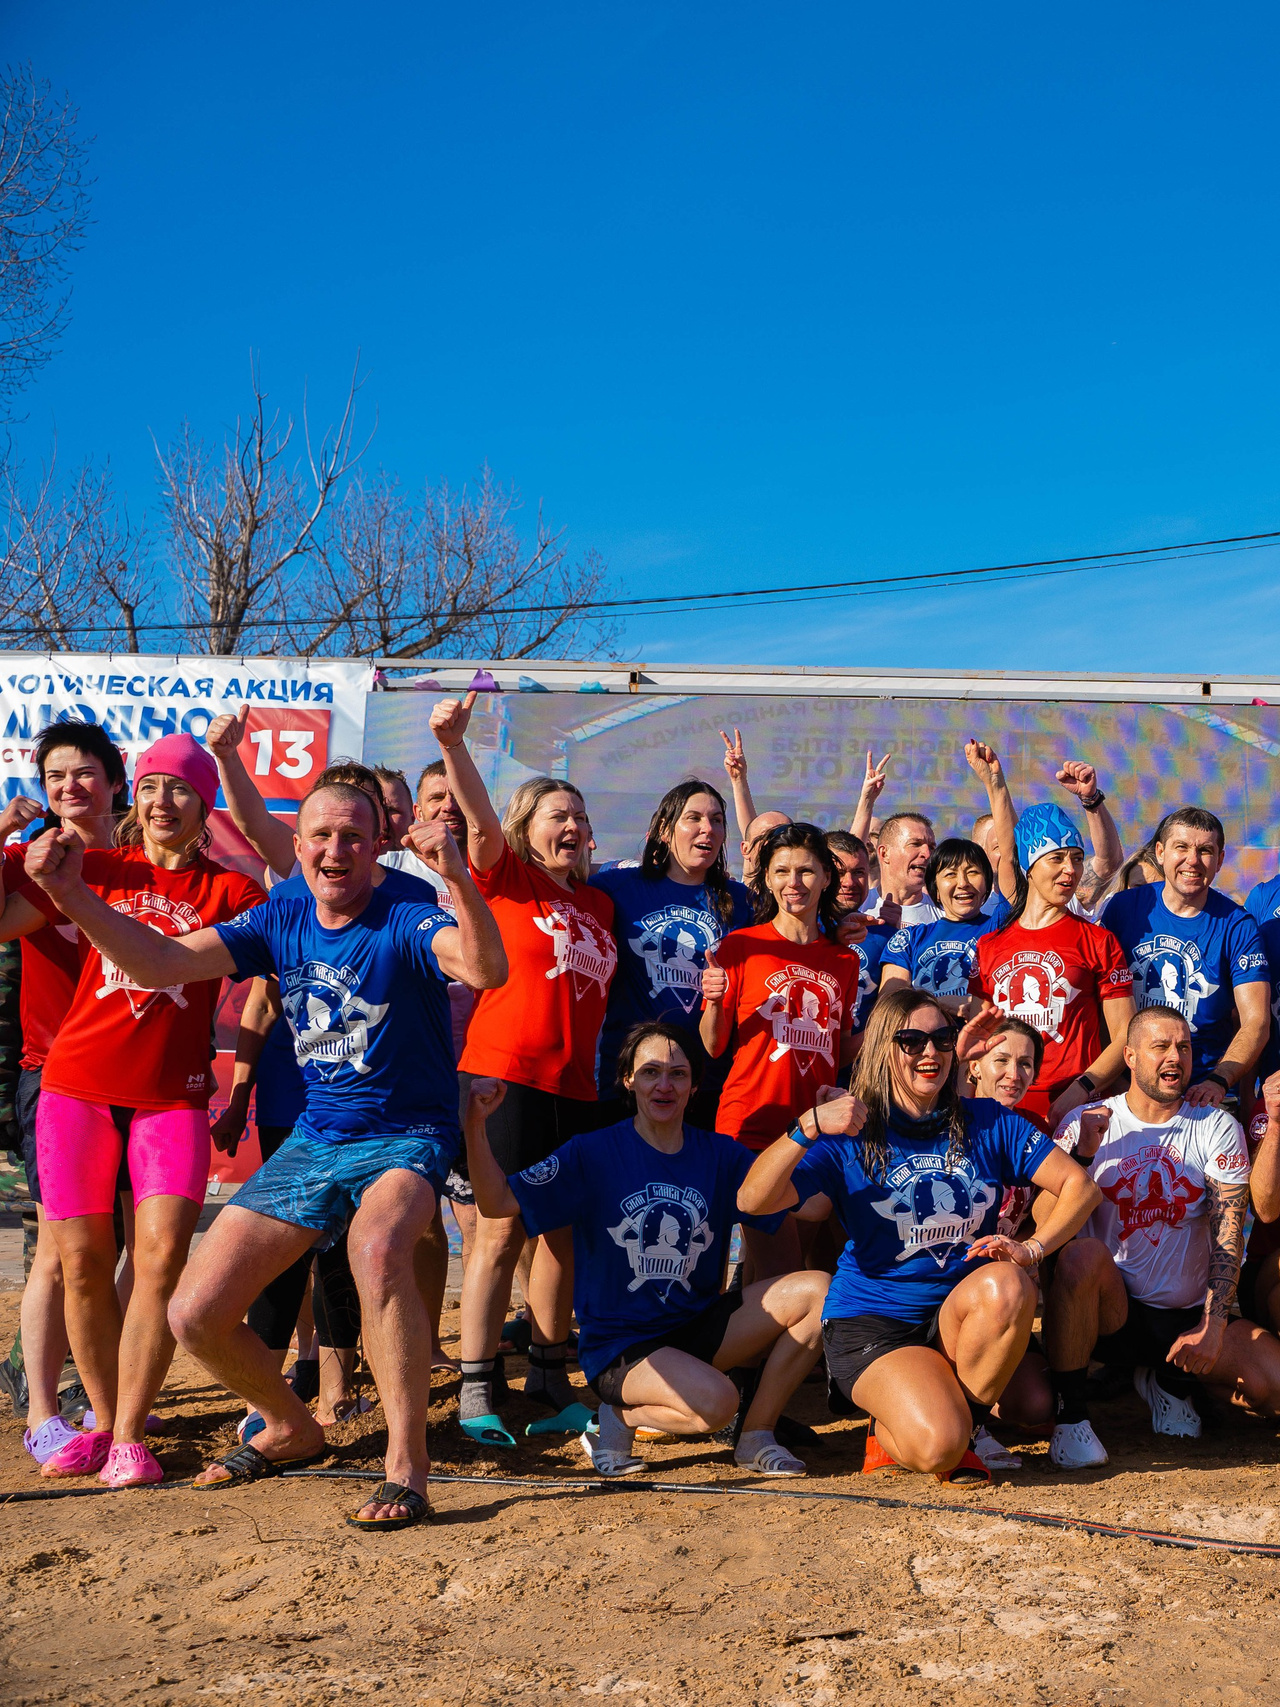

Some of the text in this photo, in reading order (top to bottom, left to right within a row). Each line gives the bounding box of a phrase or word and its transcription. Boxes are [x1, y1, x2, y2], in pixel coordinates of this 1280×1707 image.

[221, 678, 334, 704] АКЦИЯ
[249, 729, 315, 780] 13
[782, 1025, 830, 1048] ЯРОПОЛК
[913, 1155, 942, 1170] СЛАВА
[652, 1185, 680, 1201] СЛАВА
[910, 1218, 976, 1245] ЯРОПОЛК
